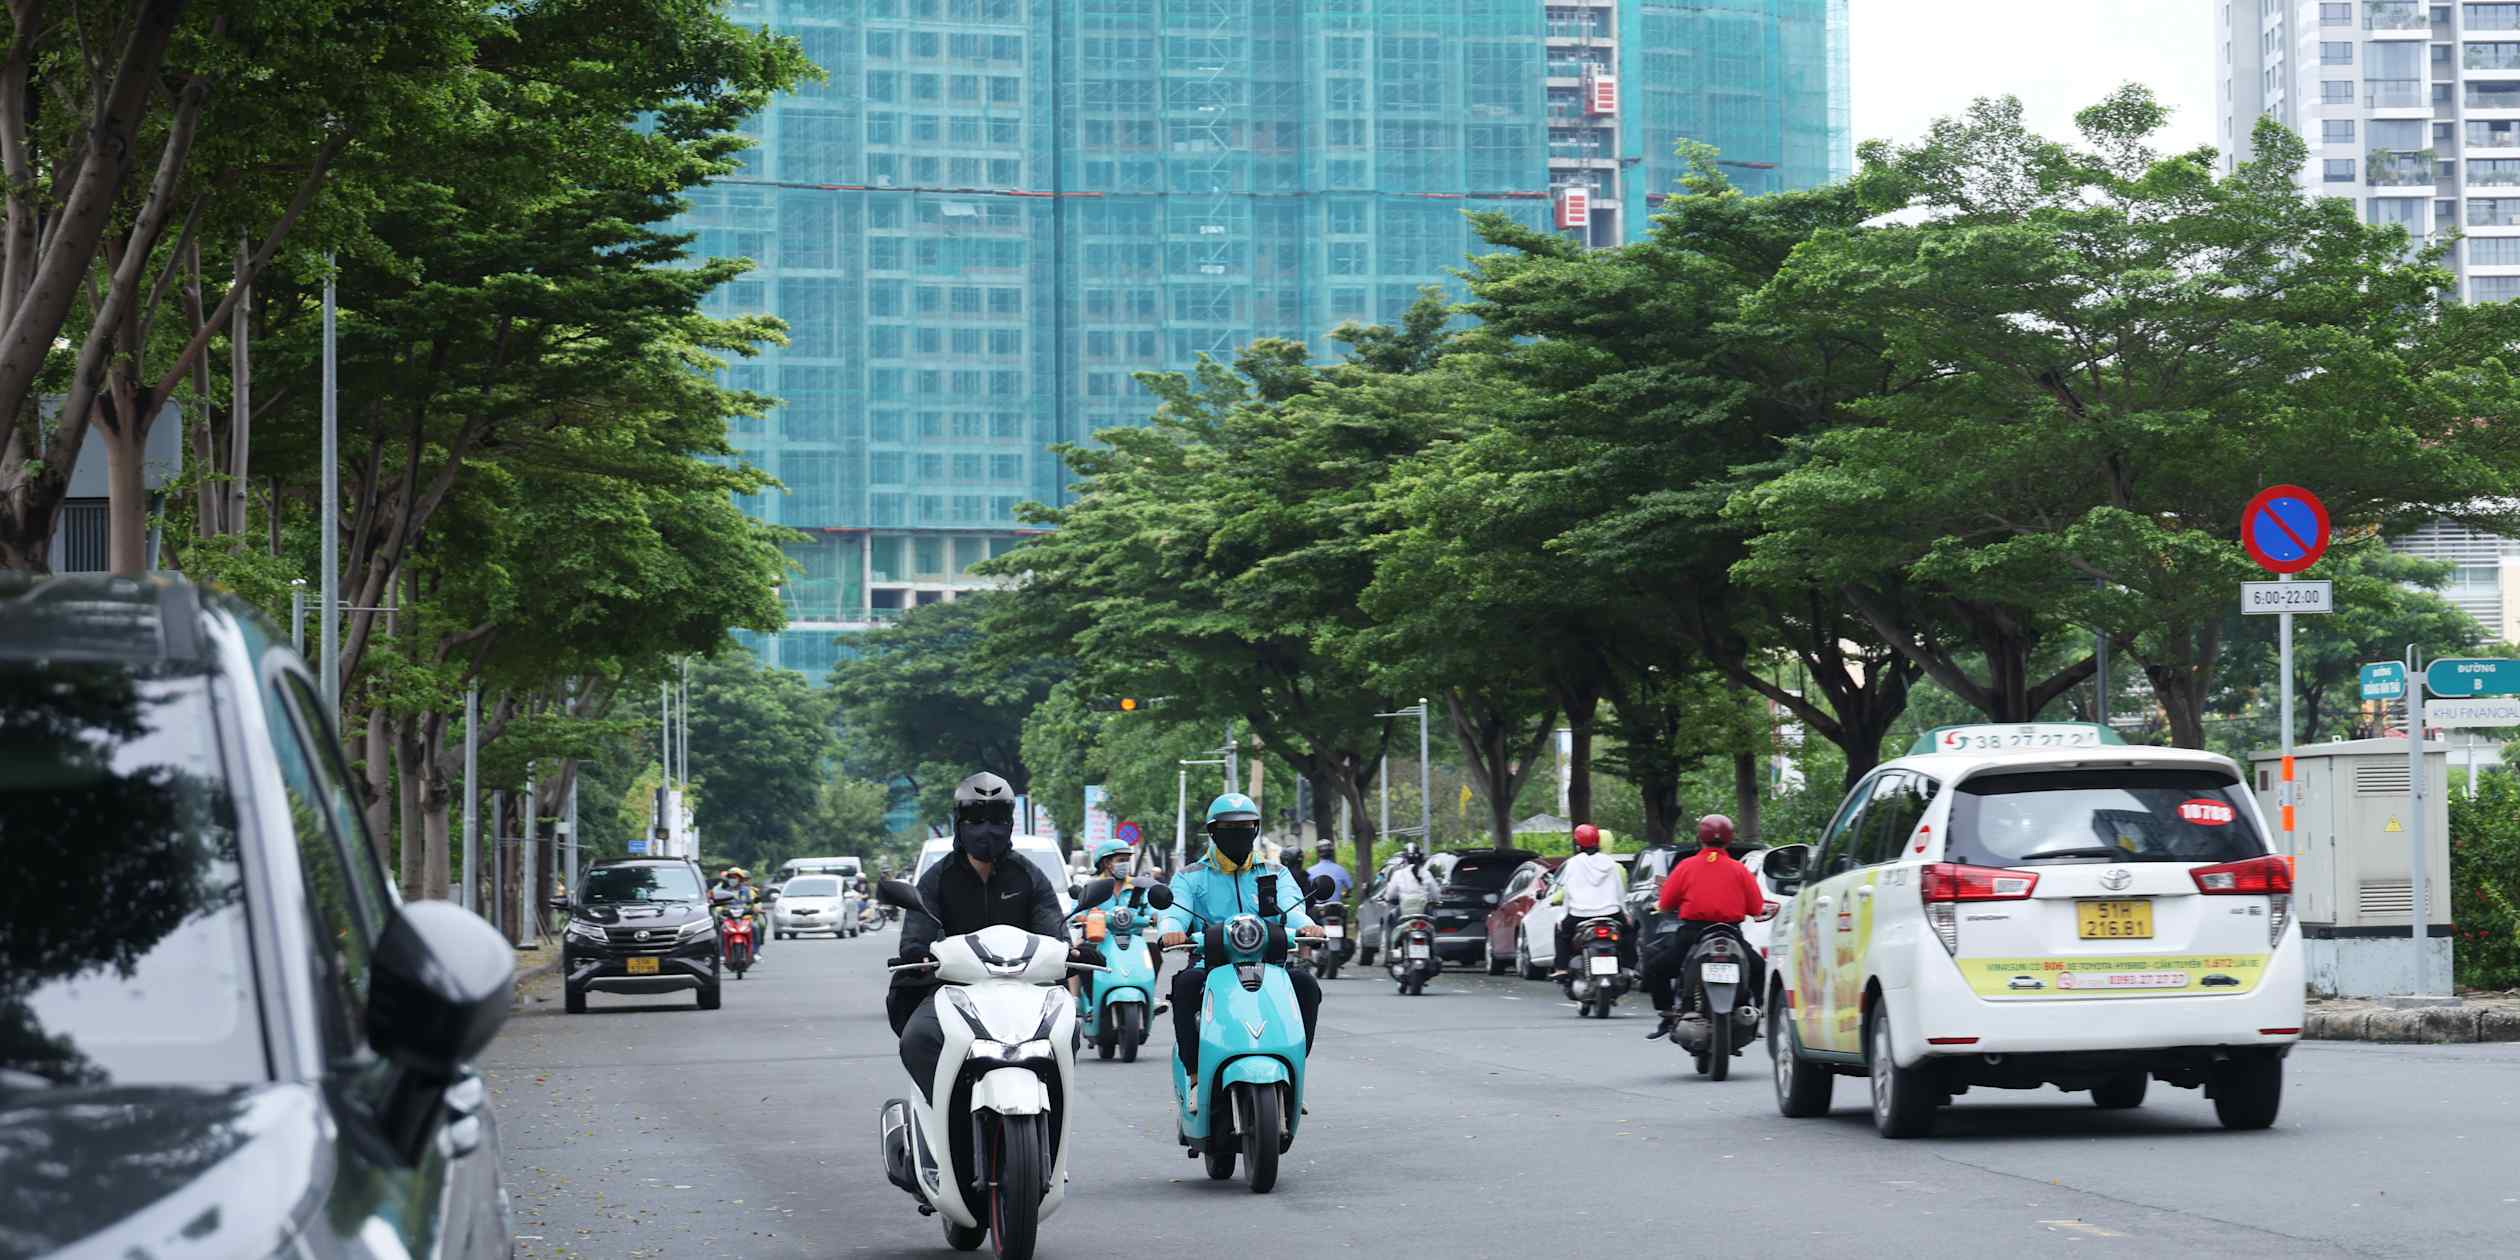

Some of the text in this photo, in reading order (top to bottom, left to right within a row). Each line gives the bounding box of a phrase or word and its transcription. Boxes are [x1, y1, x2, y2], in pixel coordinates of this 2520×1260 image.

[2255, 590, 2319, 605] 6:00-22:00
[2457, 662, 2497, 673] ĐƯỜNG
[2473, 678, 2483, 690] B
[2433, 707, 2456, 719] KHU
[1976, 735, 2000, 748] 38
[2010, 735, 2033, 746] 27
[2040, 734, 2063, 746] 27
[2099, 903, 2131, 918] 51H
[2087, 921, 2144, 936] 216.81
